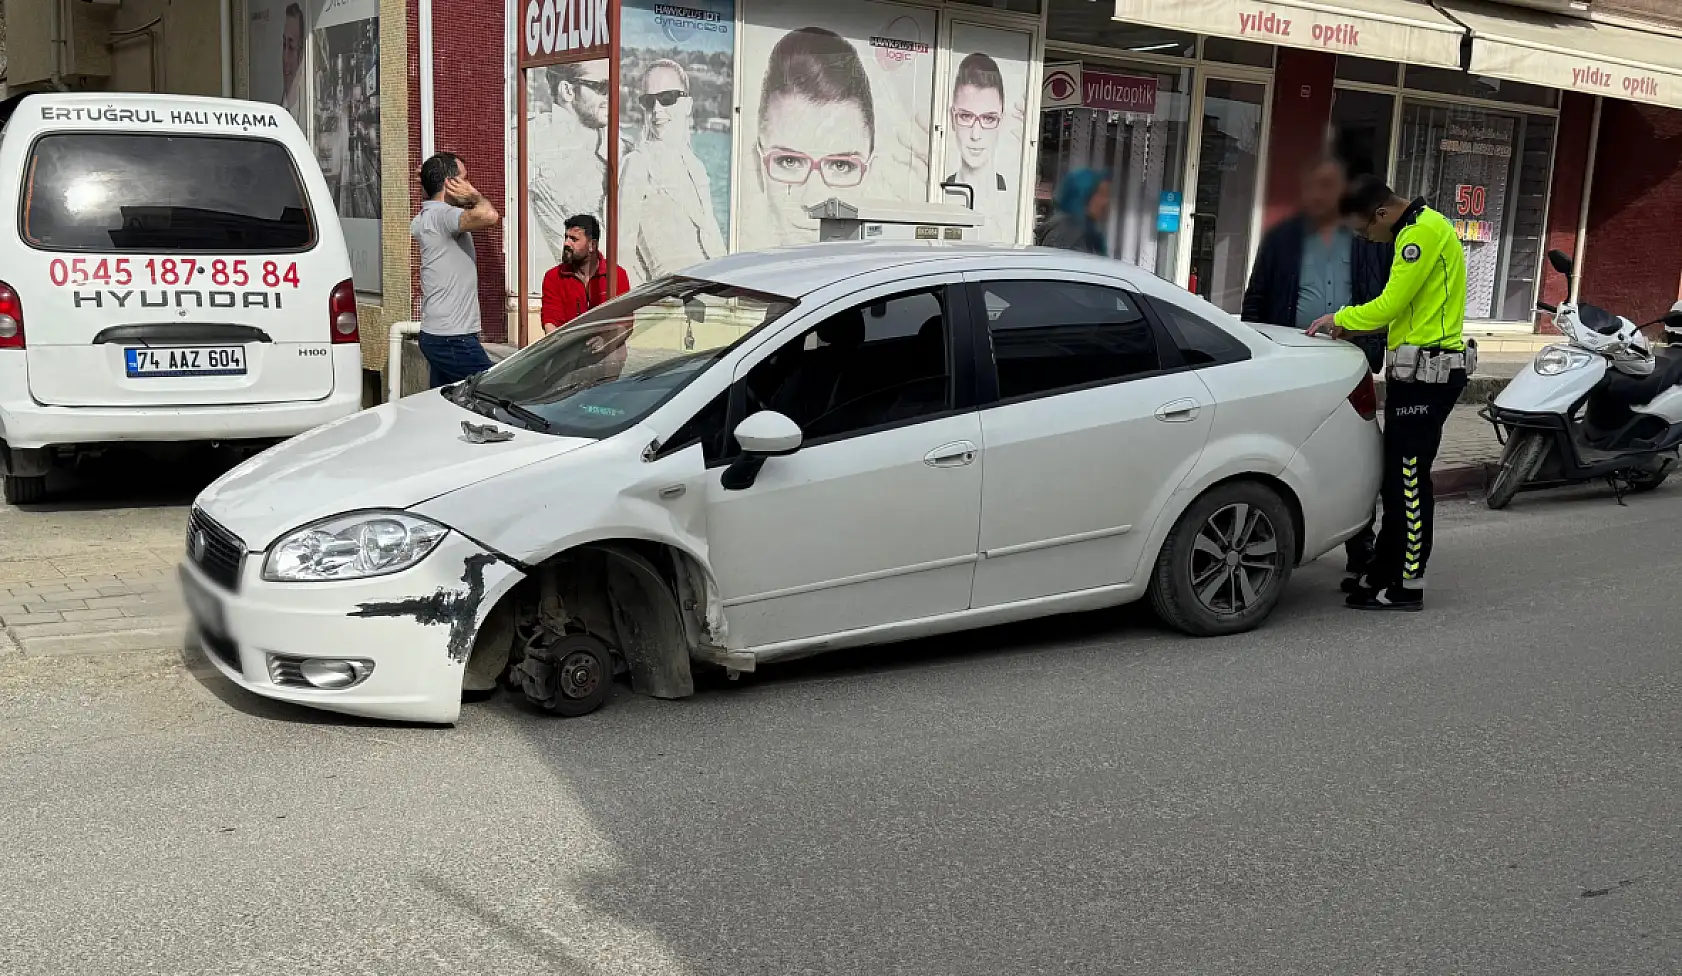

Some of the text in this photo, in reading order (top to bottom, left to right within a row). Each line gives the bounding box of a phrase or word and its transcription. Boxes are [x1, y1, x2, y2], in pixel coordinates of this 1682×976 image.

[655, 16, 704, 31] dynamic
[1239, 11, 1359, 46] yıldız optik
[886, 47, 911, 61] logic
[1572, 65, 1659, 96] yıldız optik
[1086, 79, 1153, 107] yıldızoptik
[41, 104, 279, 128] ERTUĞRUL HALI YIKAMA
[1456, 184, 1485, 216] 50
[49, 258, 301, 289] 0545 187 85 84
[74, 290, 282, 309] HYUNDAI
[138, 350, 240, 370] 74 AAZ 604
[298, 349, 327, 357] H100
